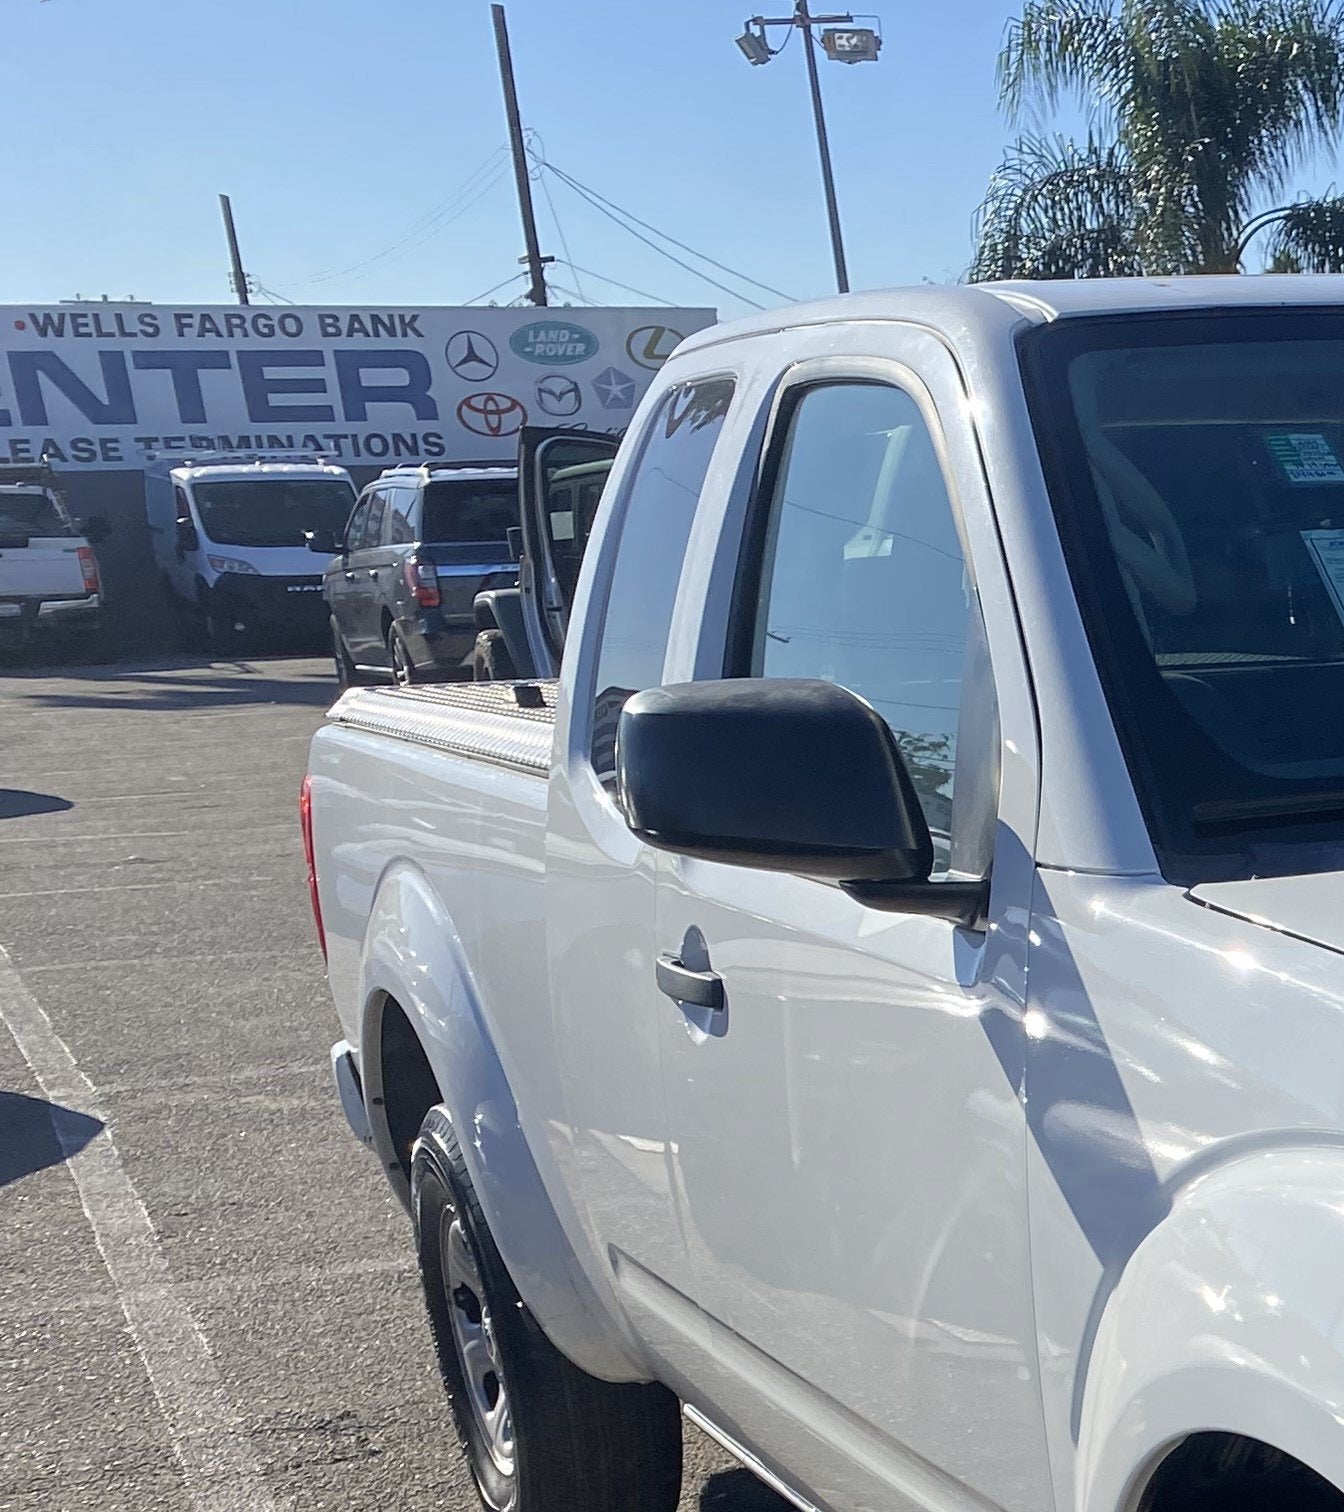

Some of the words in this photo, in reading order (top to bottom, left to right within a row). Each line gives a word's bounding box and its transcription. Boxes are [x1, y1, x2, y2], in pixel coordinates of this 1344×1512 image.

[27, 312, 161, 338] WELLS
[173, 312, 304, 338] FARGO
[317, 313, 425, 338] BANK
[0, 349, 439, 427] NTER
